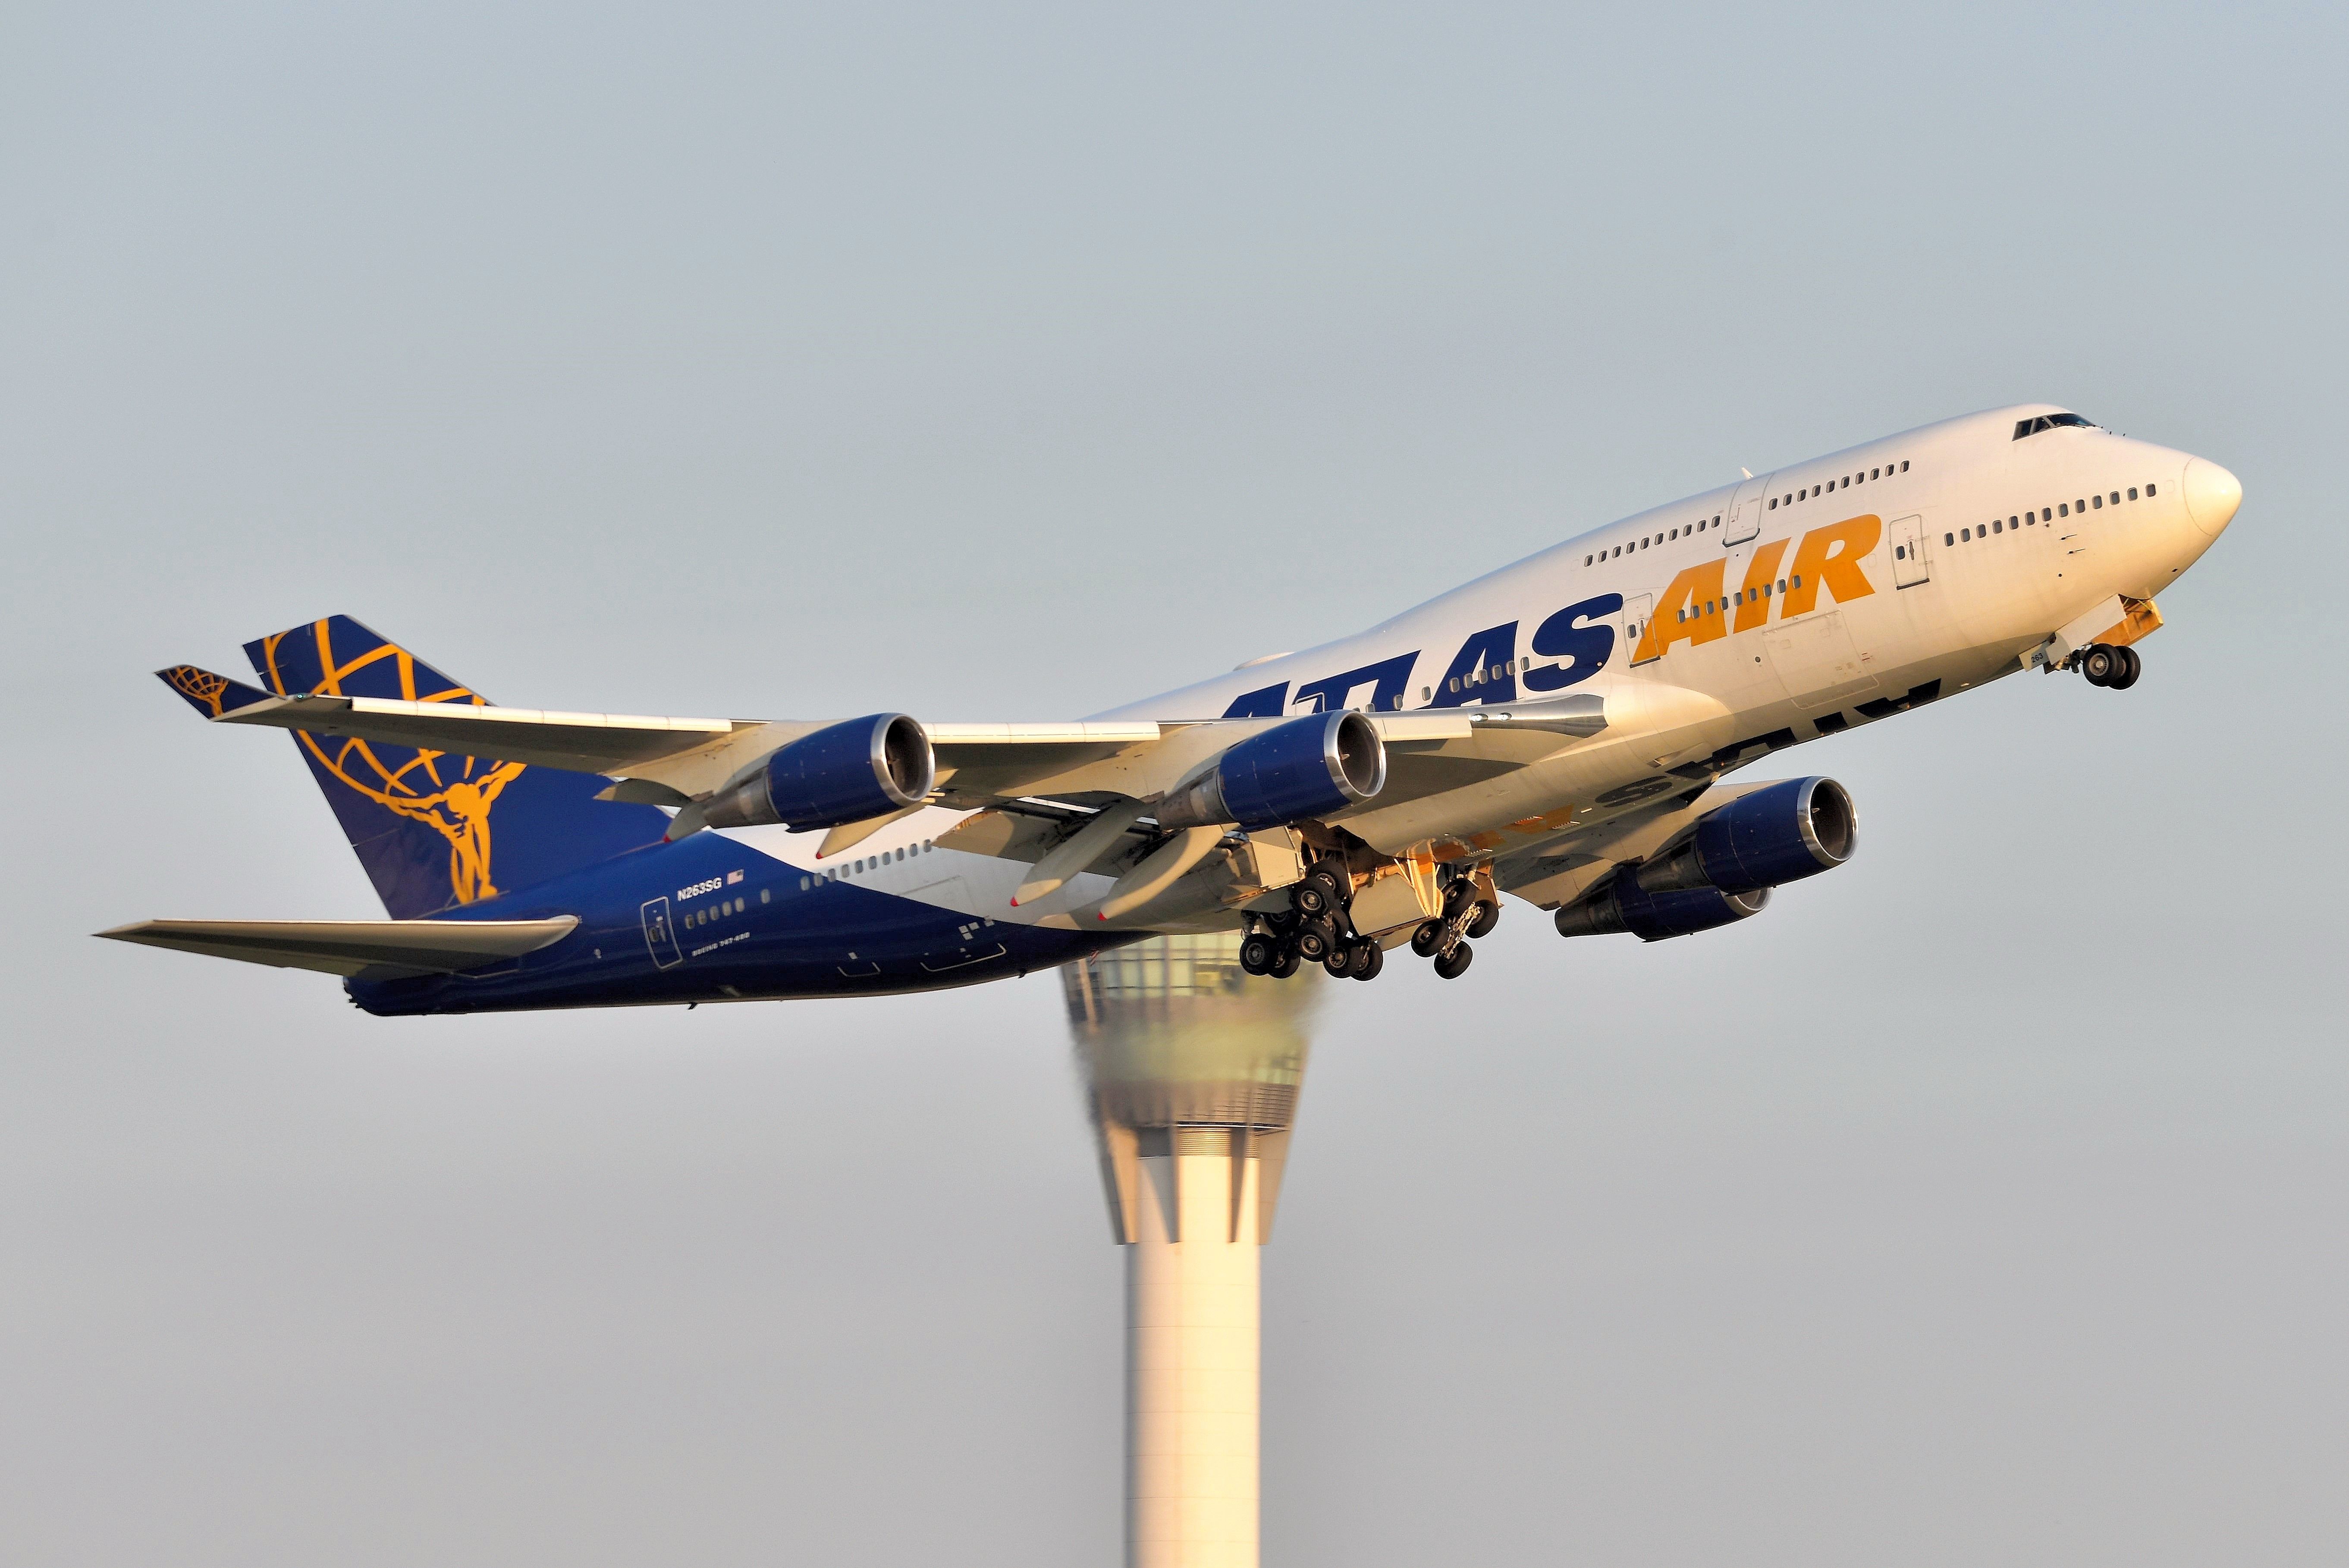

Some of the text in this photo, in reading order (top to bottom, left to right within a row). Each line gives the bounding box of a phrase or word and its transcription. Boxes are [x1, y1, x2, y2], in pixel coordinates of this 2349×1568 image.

[1631, 514, 1881, 663] AIR
[2031, 653, 2043, 663] 263
[677, 877, 722, 902] N263SG
